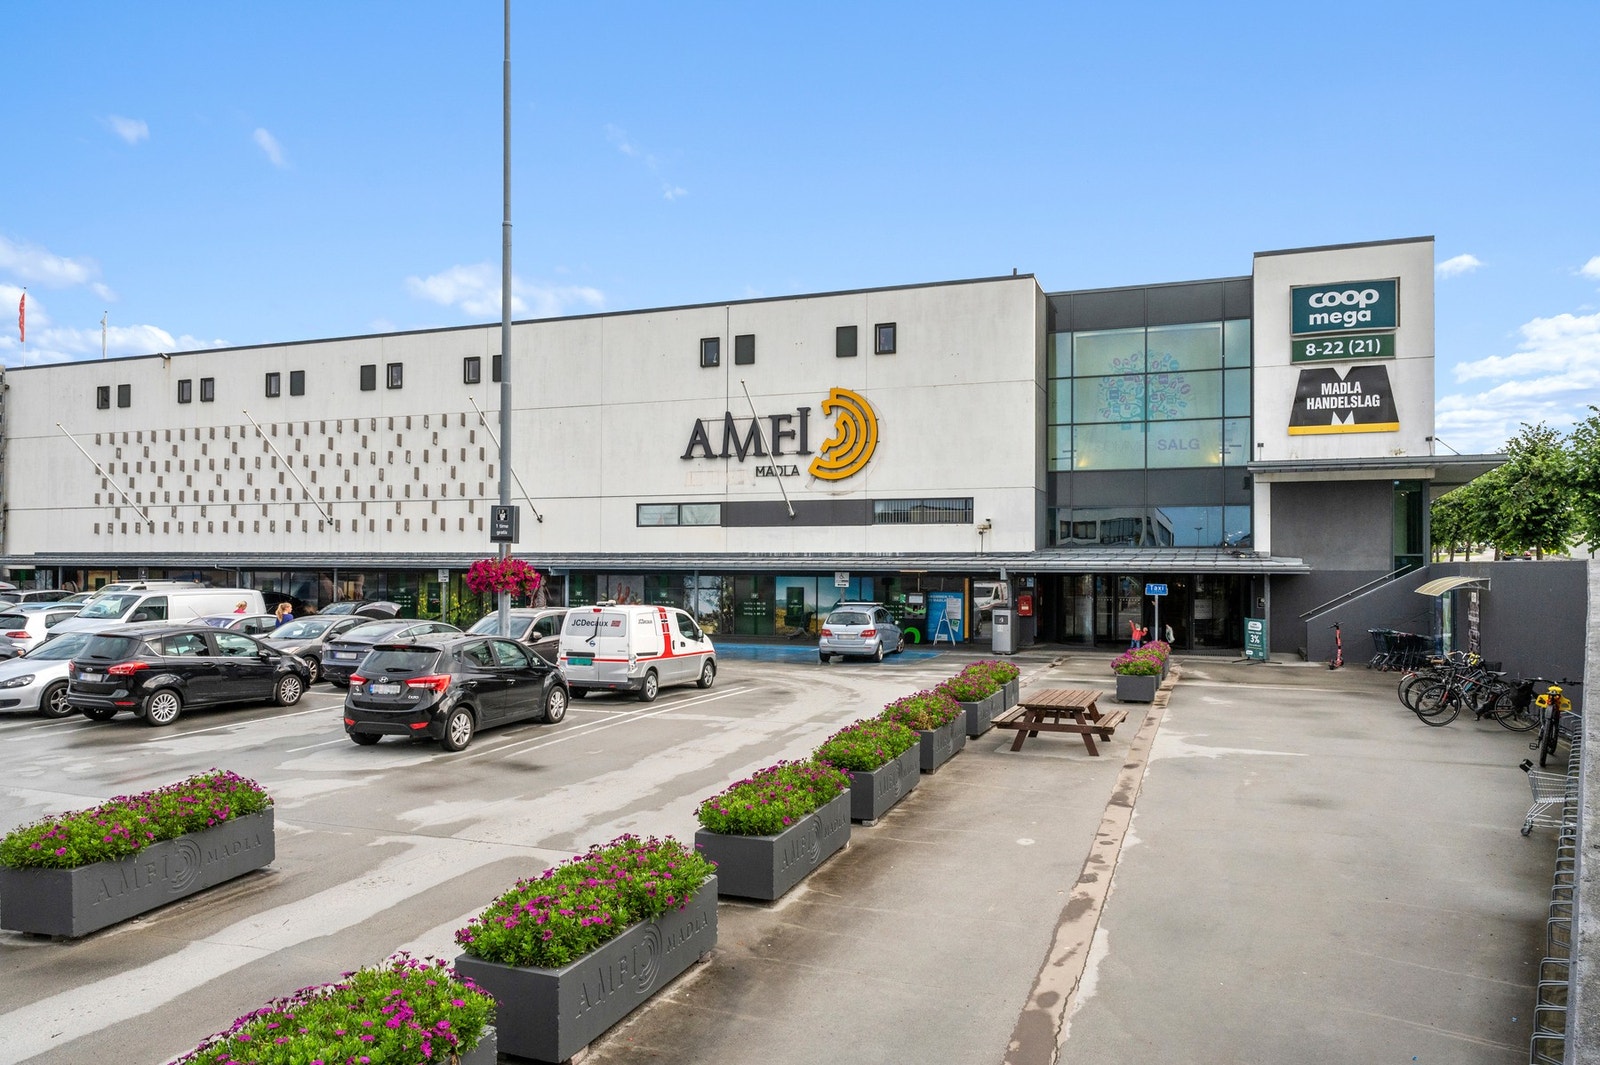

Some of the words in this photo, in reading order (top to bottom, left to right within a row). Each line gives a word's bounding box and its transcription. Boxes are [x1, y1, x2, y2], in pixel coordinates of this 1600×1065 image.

[1308, 288, 1379, 308] coop
[1309, 310, 1371, 327] mega
[1305, 341, 1344, 356] 8-22
[1348, 338, 1381, 356] (21)
[1321, 381, 1362, 396] MADLA
[1306, 395, 1380, 410] HANDELSLAG
[680, 406, 812, 462] AMFI
[756, 464, 800, 477] MADLA
[93, 854, 170, 906] AMFI
[206, 833, 262, 865] MADLA
[574, 942, 640, 1019] AMFI
[665, 910, 710, 955] MADLA
